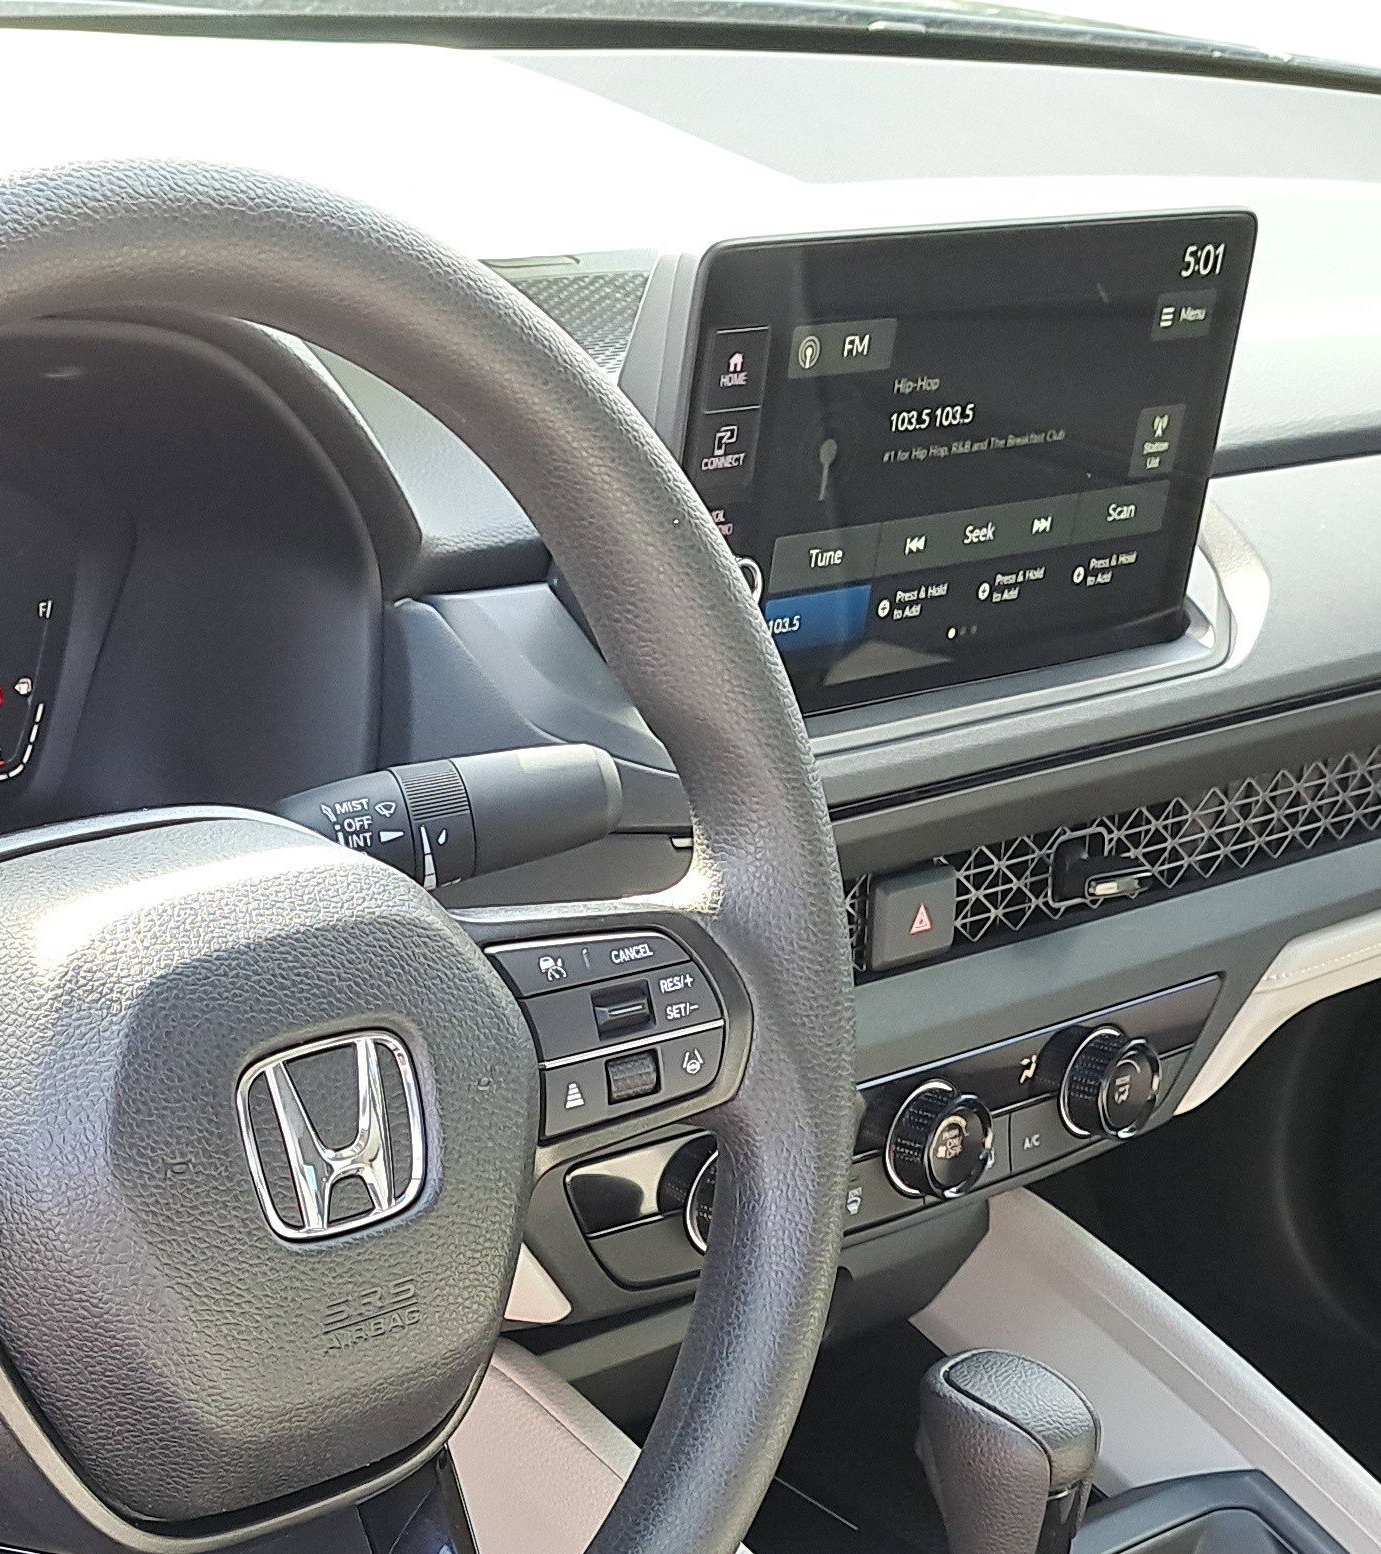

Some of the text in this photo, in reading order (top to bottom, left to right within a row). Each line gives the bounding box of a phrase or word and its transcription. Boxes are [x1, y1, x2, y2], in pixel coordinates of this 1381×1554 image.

[1180, 243, 1226, 278] 5:01
[1179, 306, 1207, 322] Menu
[843, 334, 870, 358] FM
[719, 372, 748, 388] HOME
[893, 375, 940, 395] Hip-Hop
[889, 402, 976, 432] 103.5 103.5
[700, 452, 746, 471] CONNECT
[910, 446, 928, 461] Hip
[1106, 502, 1136, 522] Scan
[963, 521, 996, 545] Seek
[808, 548, 843, 569] Tune
[1024, 566, 1046, 581] Hold
[1095, 570, 1113, 585] Add
[895, 588, 919, 602] Press
[927, 582, 949, 598] Hold
[1001, 585, 1020, 601] Add
[902, 603, 922, 619] Add
[768, 614, 801, 634] 103.5
[334, 797, 371, 815] MIST
[343, 815, 372, 832] OFF
[348, 832, 372, 849] INT
[611, 942, 654, 965] CANCEL
[659, 973, 695, 994] RES/+
[1023, 1133, 1041, 1151] A/C
[324, 1276, 417, 1326] SRS
[322, 1308, 421, 1350] AIRBAG
